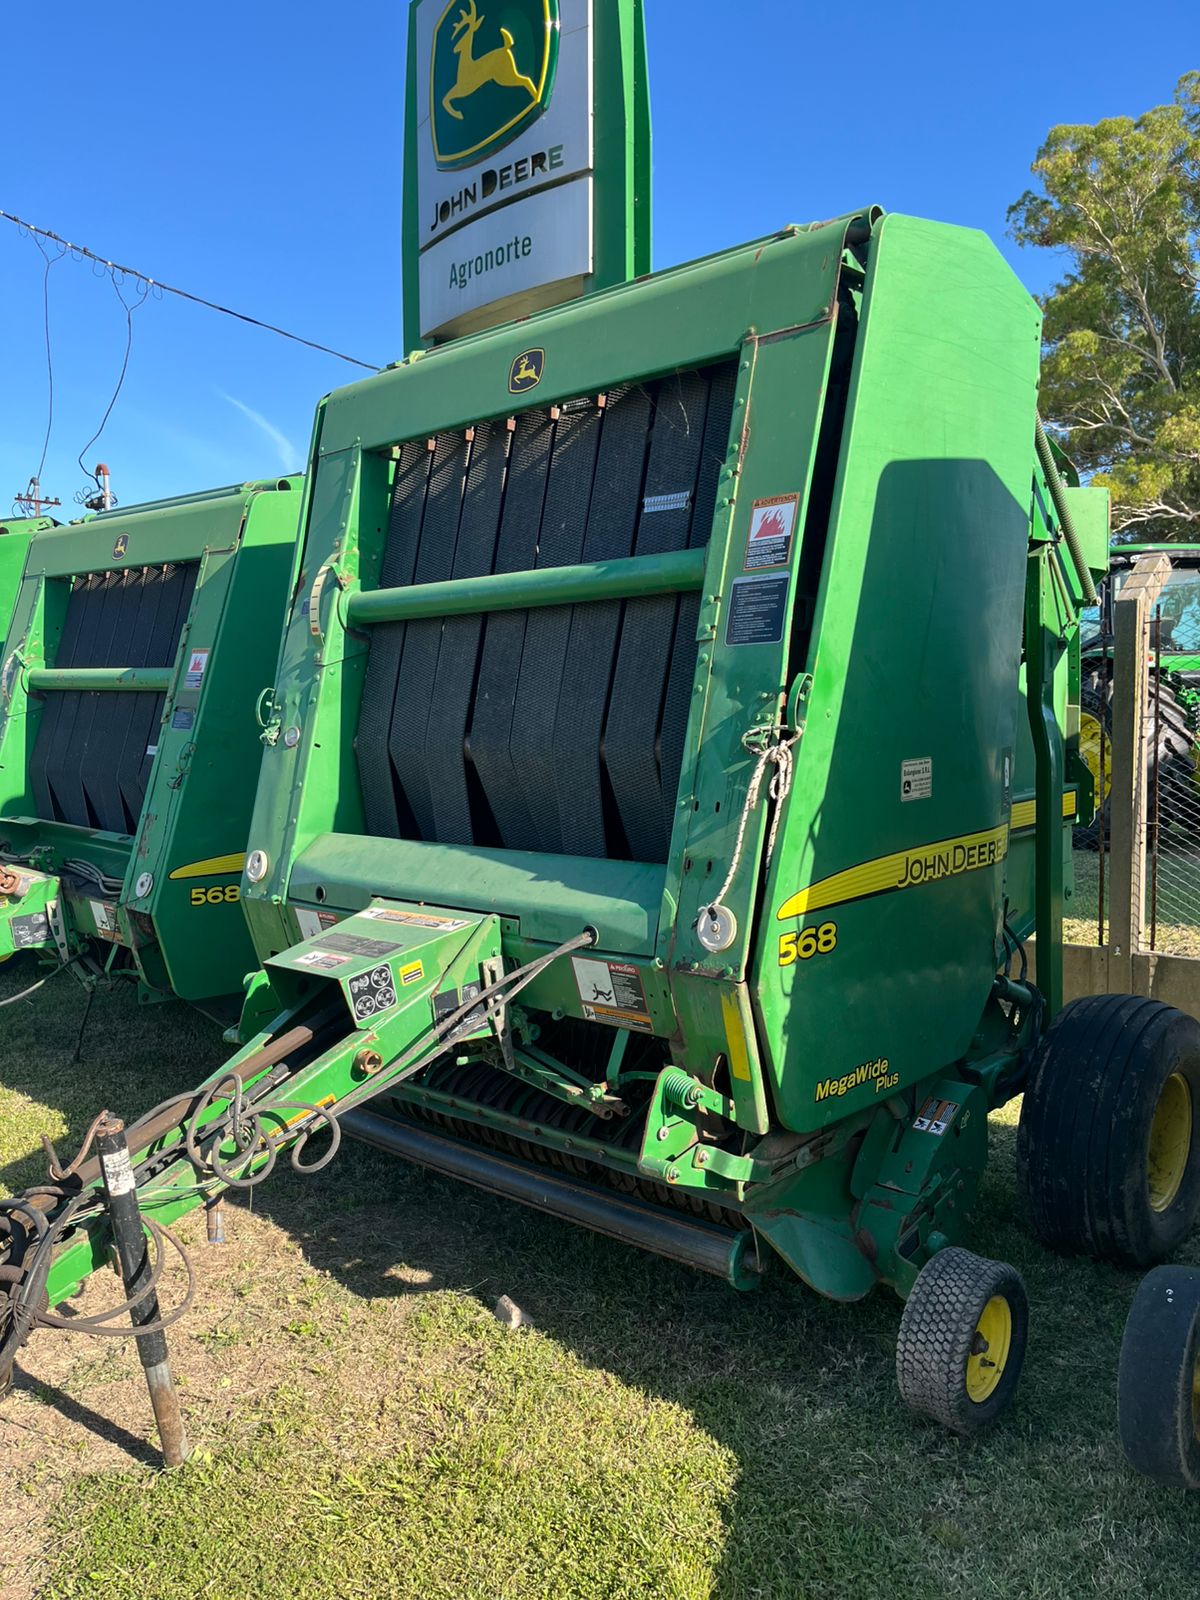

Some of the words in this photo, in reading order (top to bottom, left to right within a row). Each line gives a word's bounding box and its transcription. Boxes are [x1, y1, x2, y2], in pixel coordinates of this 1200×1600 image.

[431, 183, 477, 231] JOHN
[481, 144, 564, 198] DEERE
[449, 235, 532, 289] Agronorte
[897, 852, 950, 886] JOHN
[952, 838, 1003, 871] DEERE
[190, 884, 241, 906] 568
[778, 922, 837, 967] 568
[815, 1057, 889, 1102] MegaWide
[875, 1072, 900, 1094] Plus
